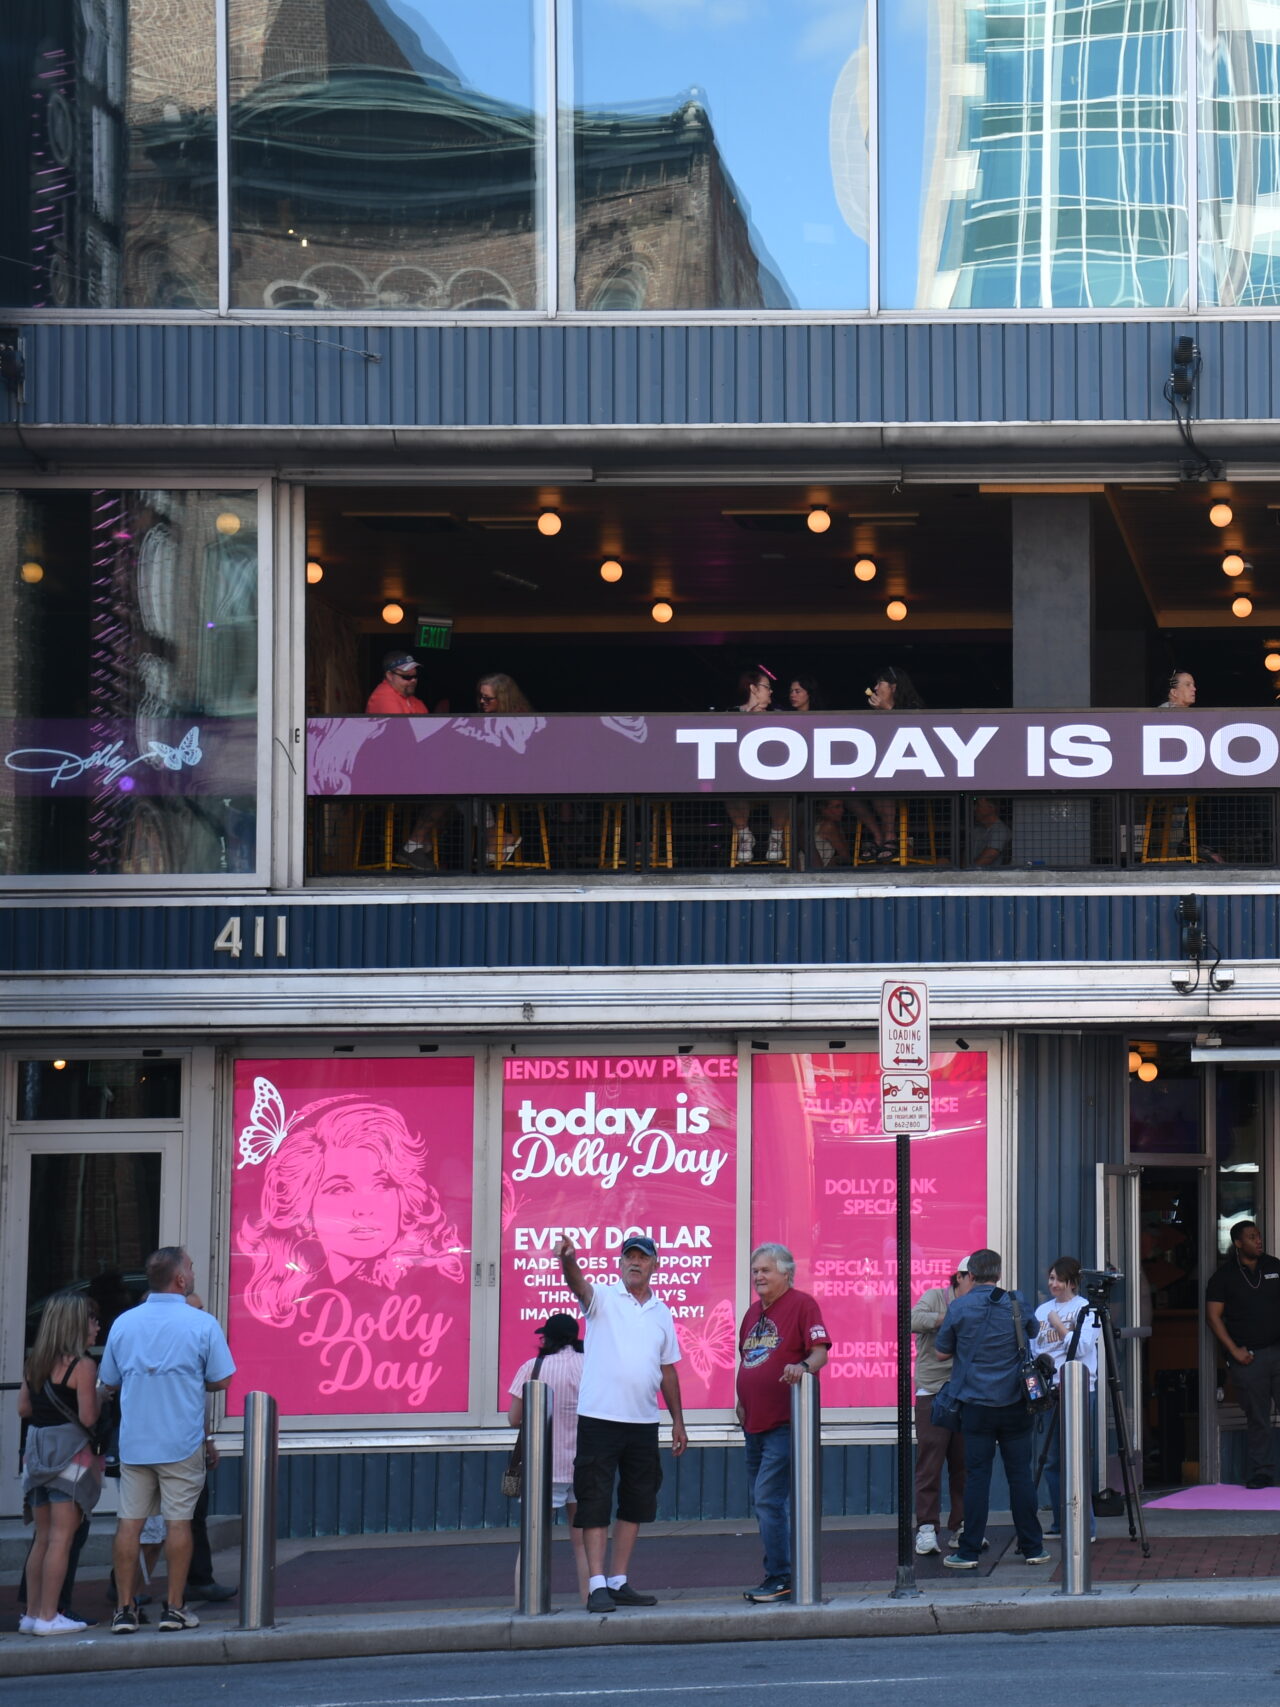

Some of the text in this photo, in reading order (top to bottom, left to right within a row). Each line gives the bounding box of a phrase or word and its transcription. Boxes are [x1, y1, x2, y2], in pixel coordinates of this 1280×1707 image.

[420, 626, 448, 648] EXIT
[676, 726, 1000, 780] TODAY
[1027, 724, 1113, 778] IS
[5, 740, 157, 788] Dolly
[214, 916, 287, 958] 411
[888, 1029, 921, 1041] LOADING
[895, 1043, 915, 1055] ZONE
[504, 1060, 569, 1079] IENDS
[576, 1060, 598, 1078] IN
[605, 1060, 657, 1079] LOW
[803, 1098, 876, 1113] ALL-DAY
[518, 1092, 710, 1147] today is
[512, 1129, 728, 1189] Dolly Day
[825, 1178, 937, 1195] DOLLY DNK
[843, 1199, 923, 1215] SPECIAS
[514, 1227, 598, 1250] EVERY
[514, 1257, 560, 1270] MADE
[578, 1257, 608, 1269] OES
[657, 1255, 712, 1268] PPORT
[814, 1259, 951, 1276] SPECIAL TBUTE
[524, 1272, 701, 1287] CHILOOD ERACY
[539, 1289, 686, 1303] THRO LY'S
[672, 1306, 704, 1318] ARY!
[298, 1288, 453, 1357] Dolly
[318, 1337, 443, 1407] Day
